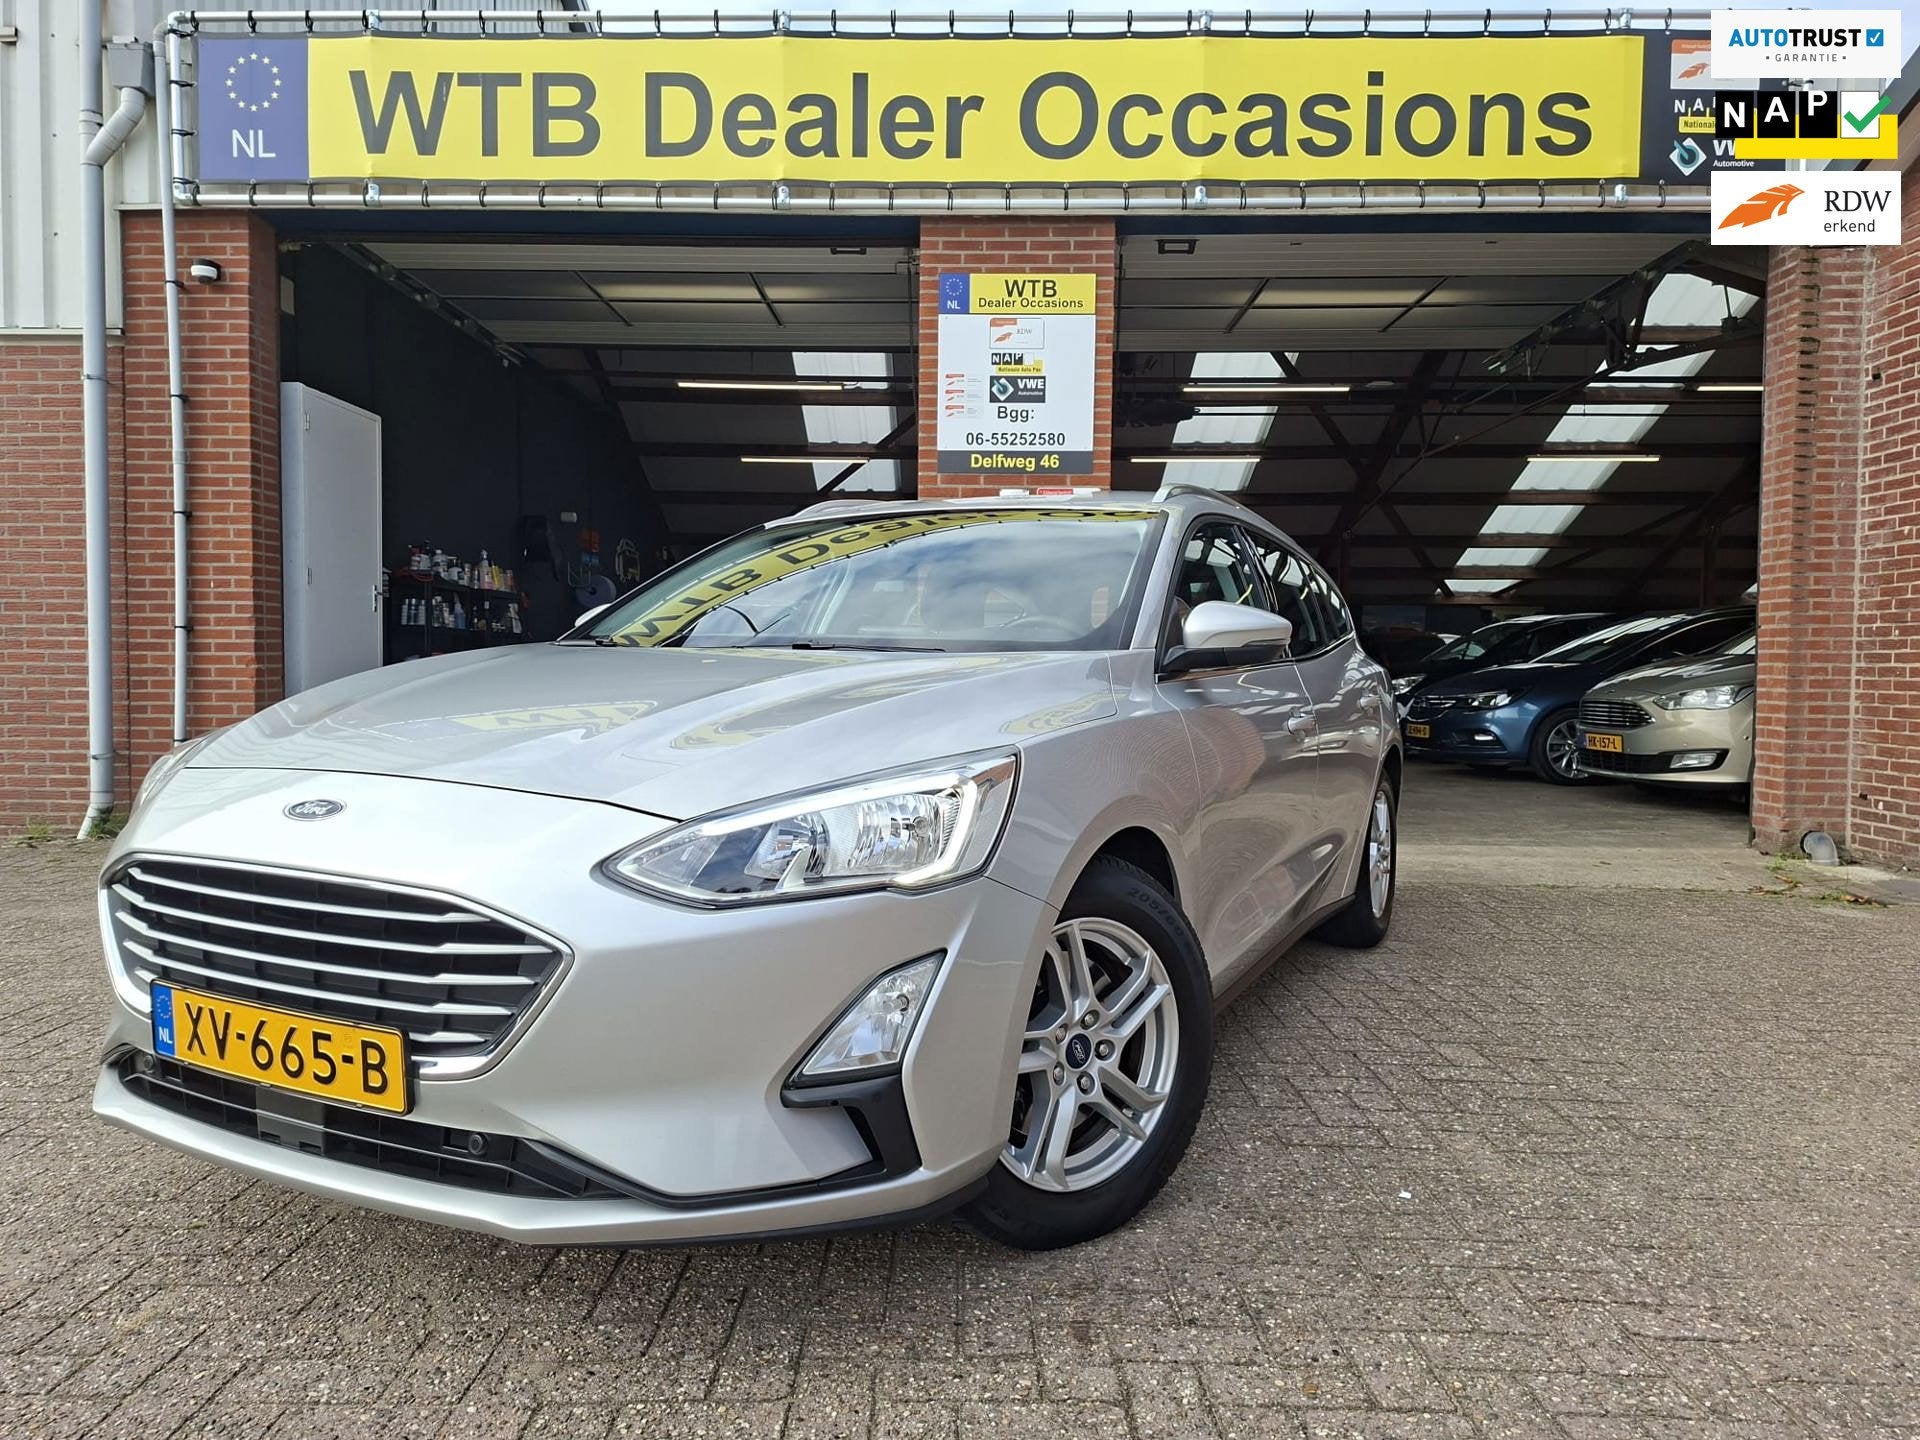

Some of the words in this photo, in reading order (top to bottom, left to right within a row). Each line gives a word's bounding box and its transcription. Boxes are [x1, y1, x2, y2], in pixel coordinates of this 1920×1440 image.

[348, 70, 602, 157] WTB
[644, 72, 985, 159] Dealer
[1018, 71, 1593, 160] Occasions
[231, 129, 277, 159] NL
[1713, 160, 1755, 168] Automotive
[1004, 279, 1058, 298] WTB
[947, 301, 961, 310] NL
[978, 297, 1016, 308] Dealer
[1020, 297, 1084, 308] Occasions
[1018, 378, 1045, 389] VWE
[997, 406, 1035, 422] Bgg:
[966, 432, 1066, 446] 06-55252580
[970, 453, 1036, 472] Delfweg
[1040, 454, 1060, 468] 46
[158, 1026, 173, 1044] NL
[184, 1001, 388, 1095] XV-665-B
